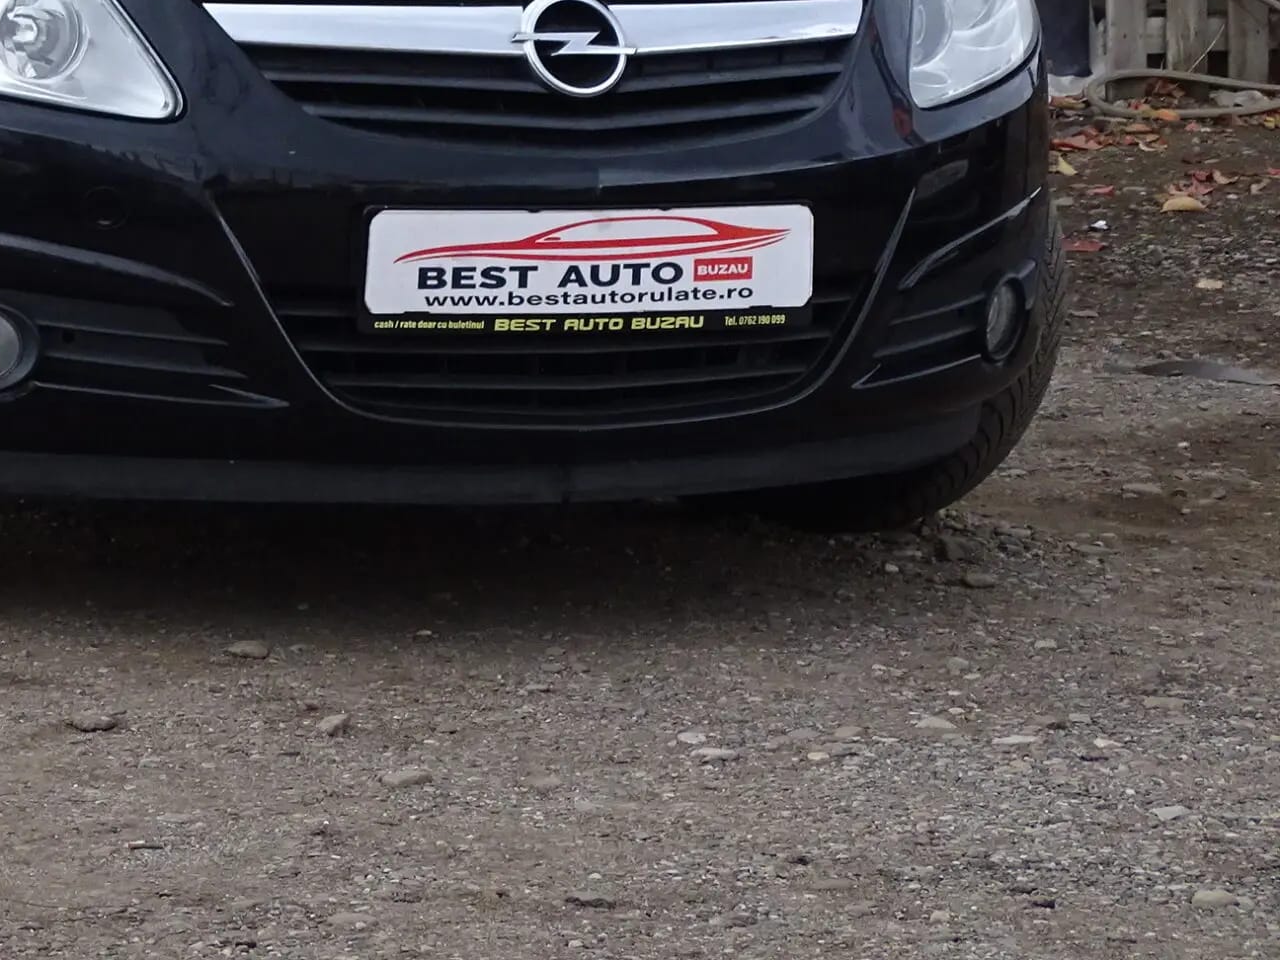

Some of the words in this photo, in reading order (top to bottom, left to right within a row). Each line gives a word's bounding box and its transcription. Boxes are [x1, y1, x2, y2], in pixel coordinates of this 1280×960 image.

[417, 265, 538, 290] BEST
[558, 261, 683, 287] AUTO
[697, 263, 749, 275] BUZAU
[425, 287, 753, 307] www.bestautorulate.ro
[374, 320, 393, 329] cash
[400, 320, 417, 329] rate
[418, 320, 436, 329] doar
[437, 321, 447, 329] cu
[494, 319, 556, 331] BEST
[564, 318, 624, 330] AUTO
[631, 316, 704, 329] BUZAU
[725, 316, 737, 326] Tel.
